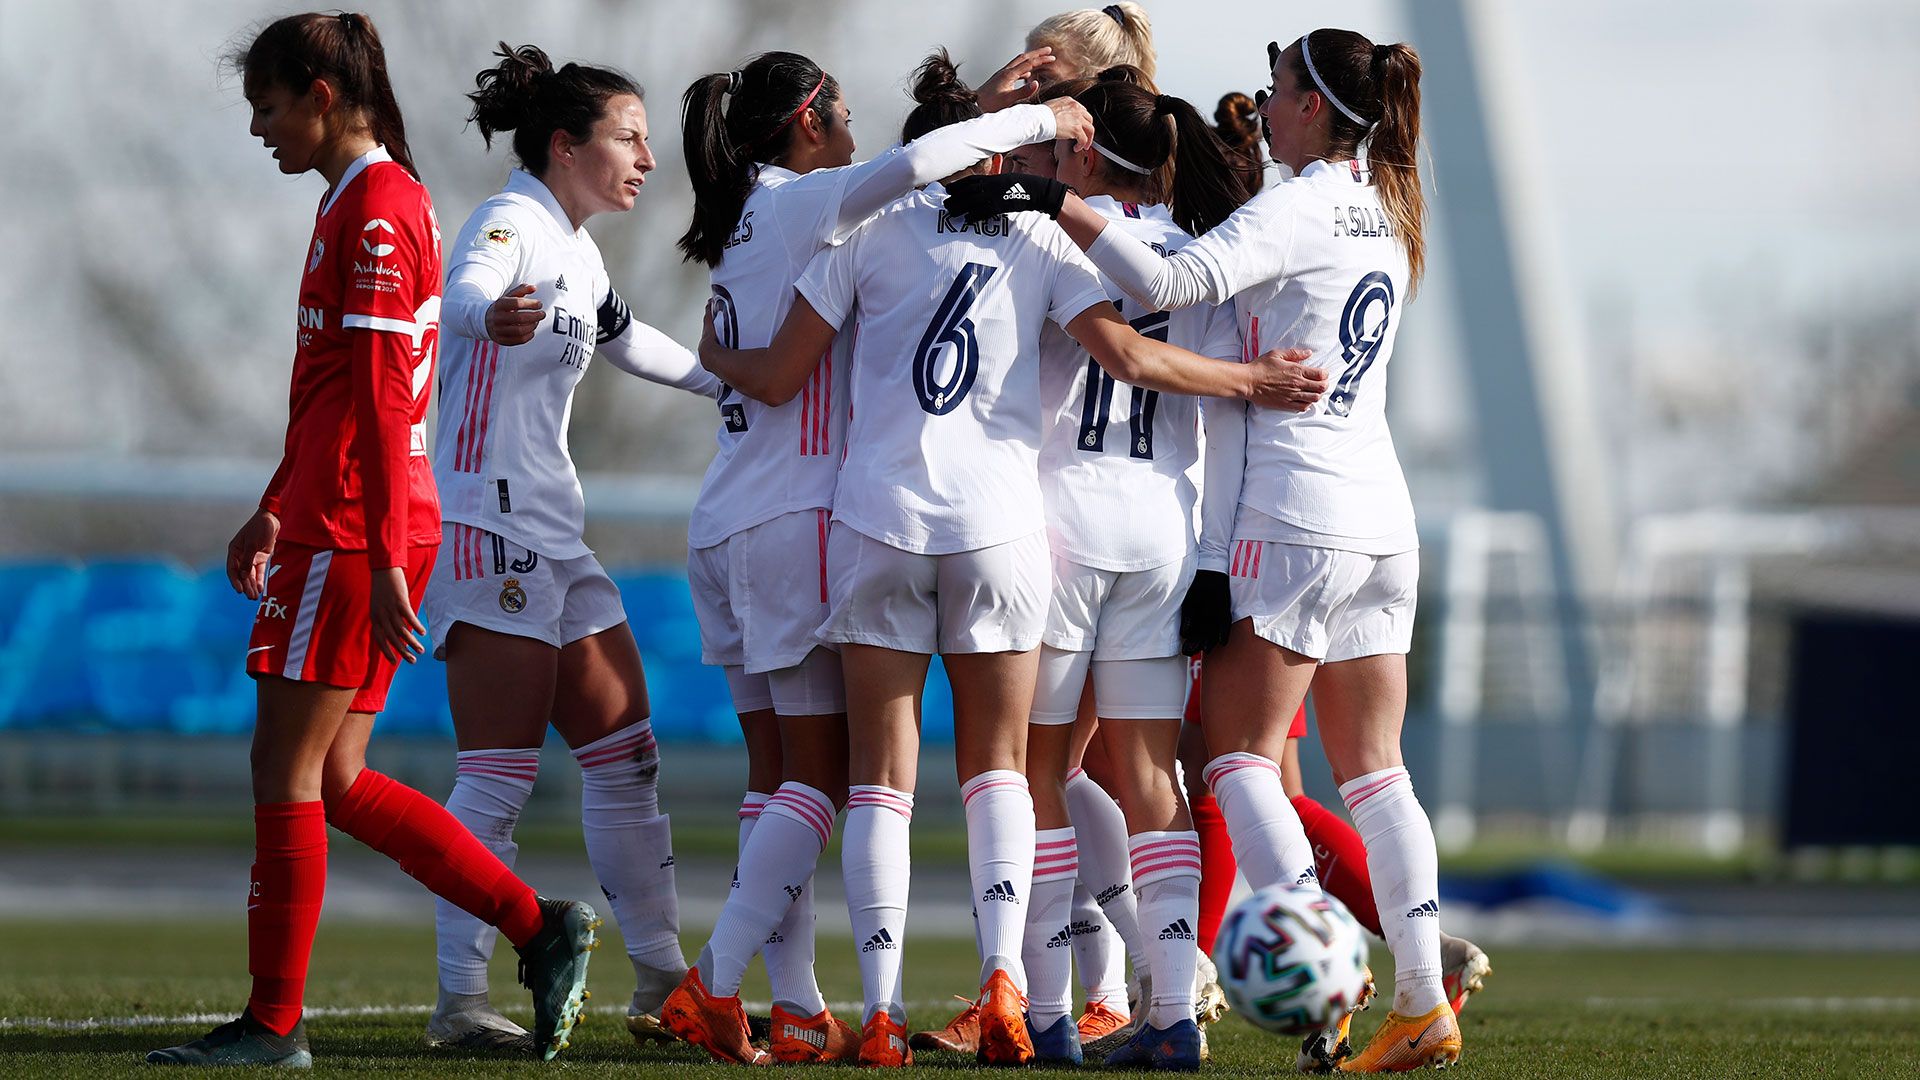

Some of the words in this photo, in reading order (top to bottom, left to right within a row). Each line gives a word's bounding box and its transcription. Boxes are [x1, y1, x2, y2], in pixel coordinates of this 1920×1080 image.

[1003, 193, 1031, 201] adidas
[1333, 205, 1394, 238] ASLLA
[353, 260, 404, 281] Andalucía
[297, 305, 325, 331] ON
[552, 305, 595, 347] Emira
[912, 262, 998, 416] 6
[1324, 271, 1396, 418] 9
[559, 342, 580, 367] FLY
[1077, 298, 1171, 459] 11
[982, 892, 1020, 905] adidas
[862, 941, 897, 953] adidas
[1158, 931, 1195, 941] adidas
[783, 1023, 826, 1050] PUMA
